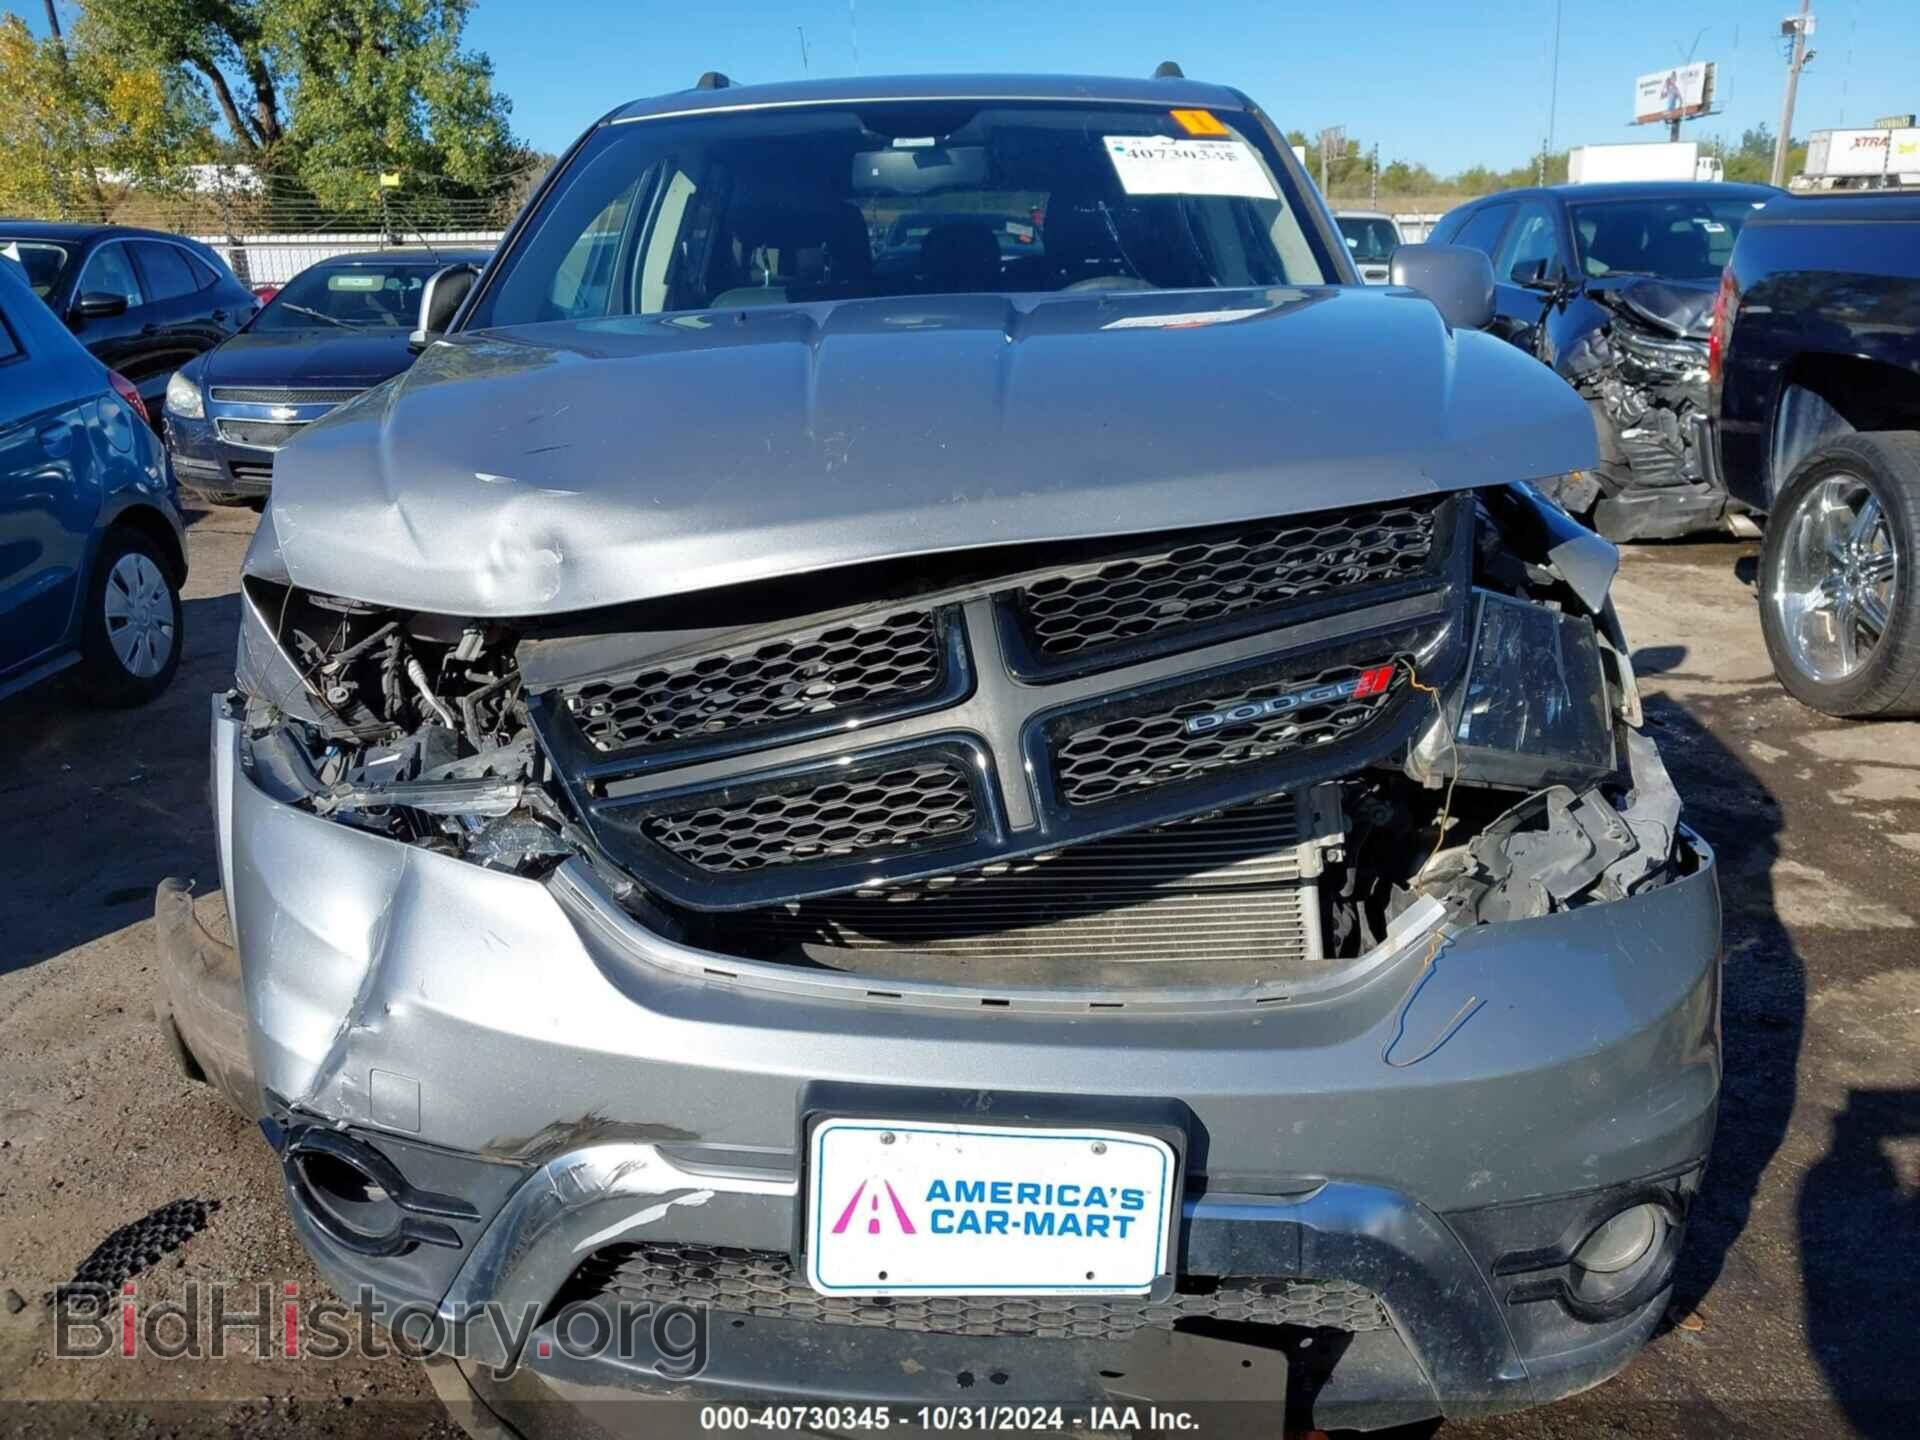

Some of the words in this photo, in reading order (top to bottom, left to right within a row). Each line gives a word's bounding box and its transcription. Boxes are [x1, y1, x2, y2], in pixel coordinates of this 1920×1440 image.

[1849, 136, 1889, 151] XTRA
[1187, 679, 1364, 731] DODGE
[926, 1179, 1145, 1210] AMERICA'S
[931, 1209, 1136, 1238] CAR-MART
